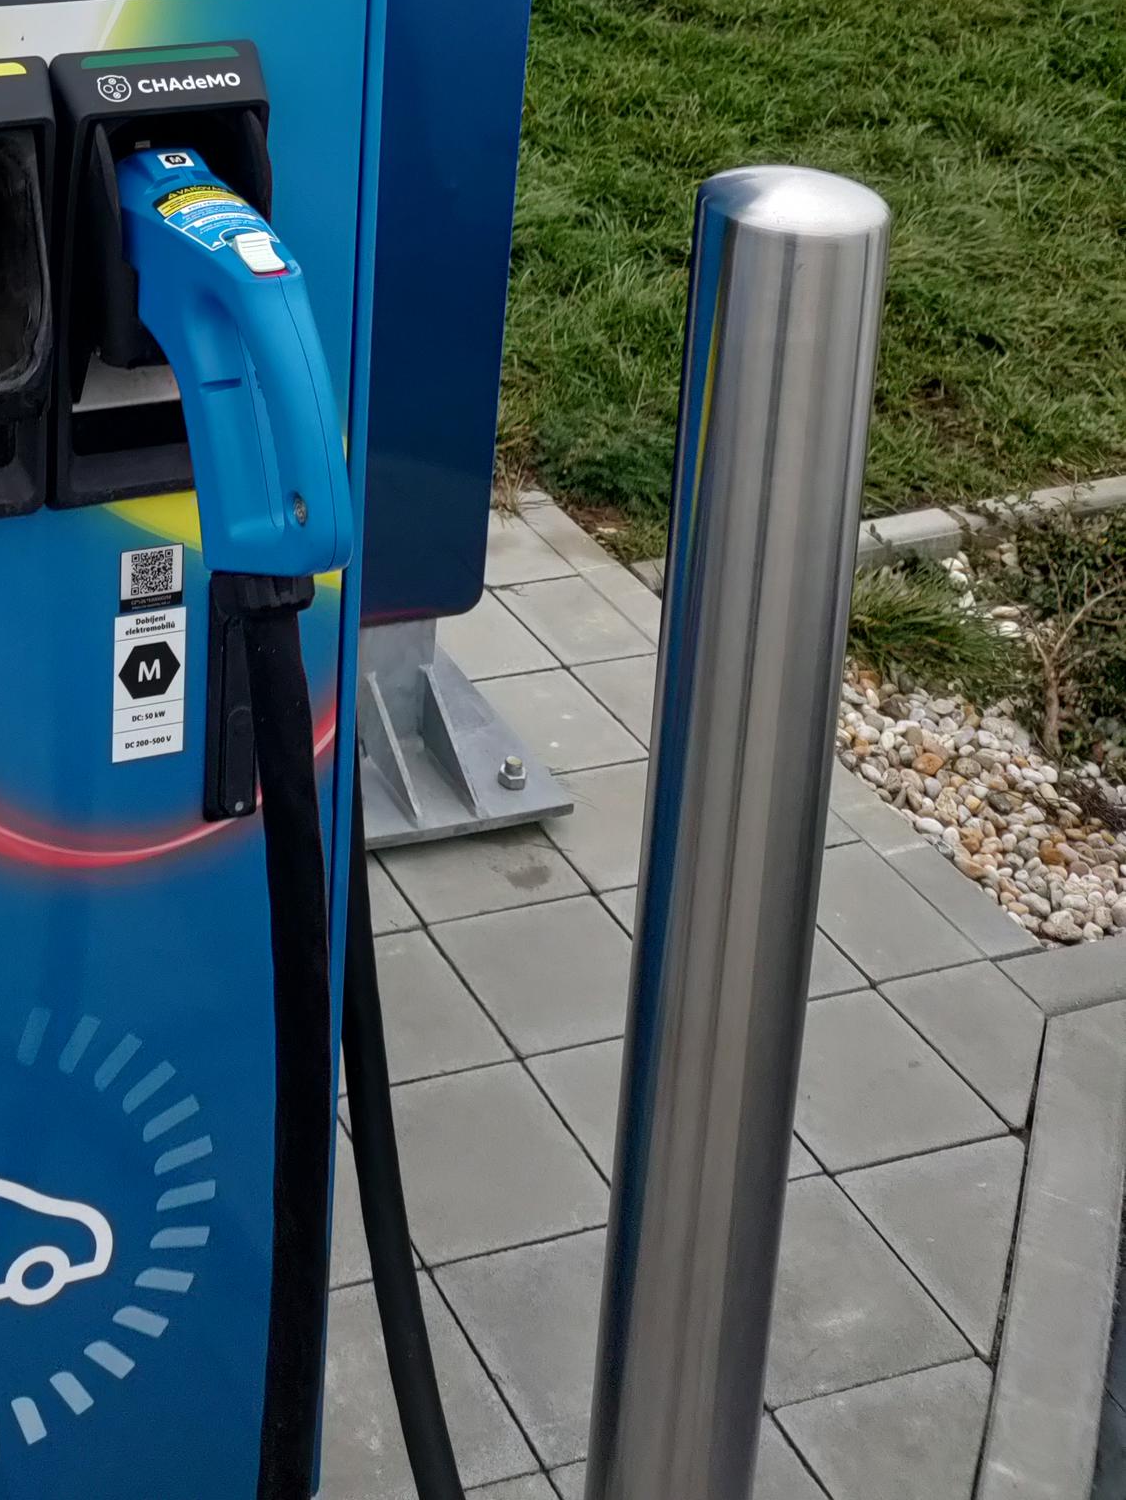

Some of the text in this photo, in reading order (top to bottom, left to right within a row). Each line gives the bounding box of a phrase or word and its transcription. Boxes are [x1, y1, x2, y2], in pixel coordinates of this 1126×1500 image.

[137, 72, 241, 95] CHAdeMO
[169, 156, 183, 164] M
[135, 615, 166, 626] Dobíjení
[125, 622, 176, 636] elektromobilů
[138, 658, 161, 683] M
[131, 710, 166, 722] DC: 50 kW
[125, 741, 135, 749] DC
[166, 735, 172, 743] V
